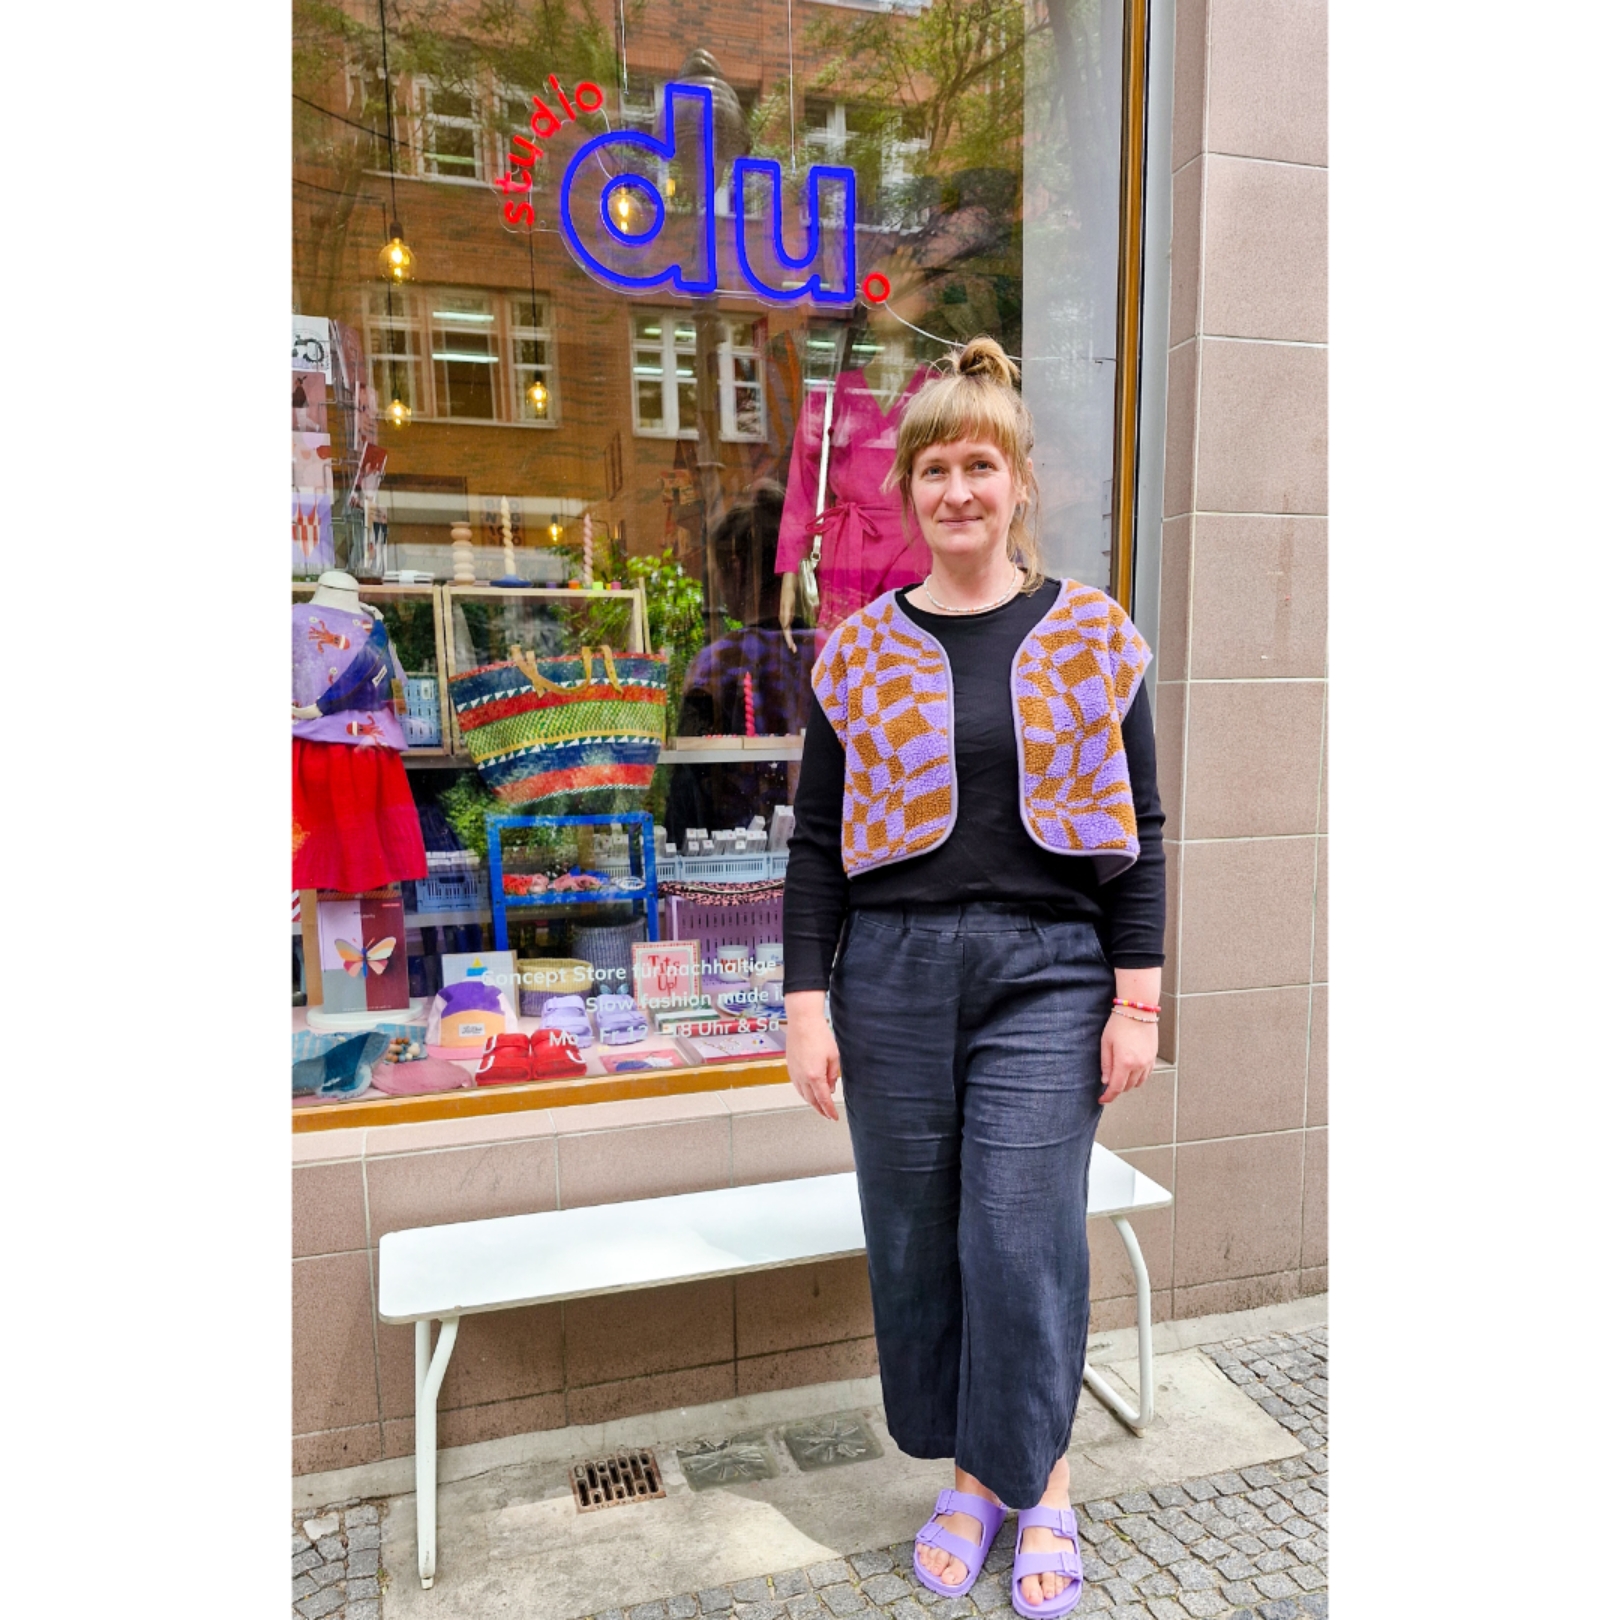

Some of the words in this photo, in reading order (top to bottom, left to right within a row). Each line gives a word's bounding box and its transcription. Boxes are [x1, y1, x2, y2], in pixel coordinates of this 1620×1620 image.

[495, 74, 604, 226] studio
[481, 969, 567, 987] Concept
[573, 966, 626, 982] Store
[632, 962, 659, 979] für
[666, 957, 776, 978] nachhaltige
[586, 996, 634, 1013] Slow
[639, 991, 711, 1010] fashion
[718, 986, 769, 1004] made
[550, 1030, 578, 1047] Mo
[600, 1028, 620, 1044] Fr
[627, 1024, 648, 1043] 12
[672, 1022, 692, 1038] 18
[698, 1020, 733, 1036] Uhr
[737, 1019, 751, 1033] &
[756, 1017, 780, 1032] Sa
